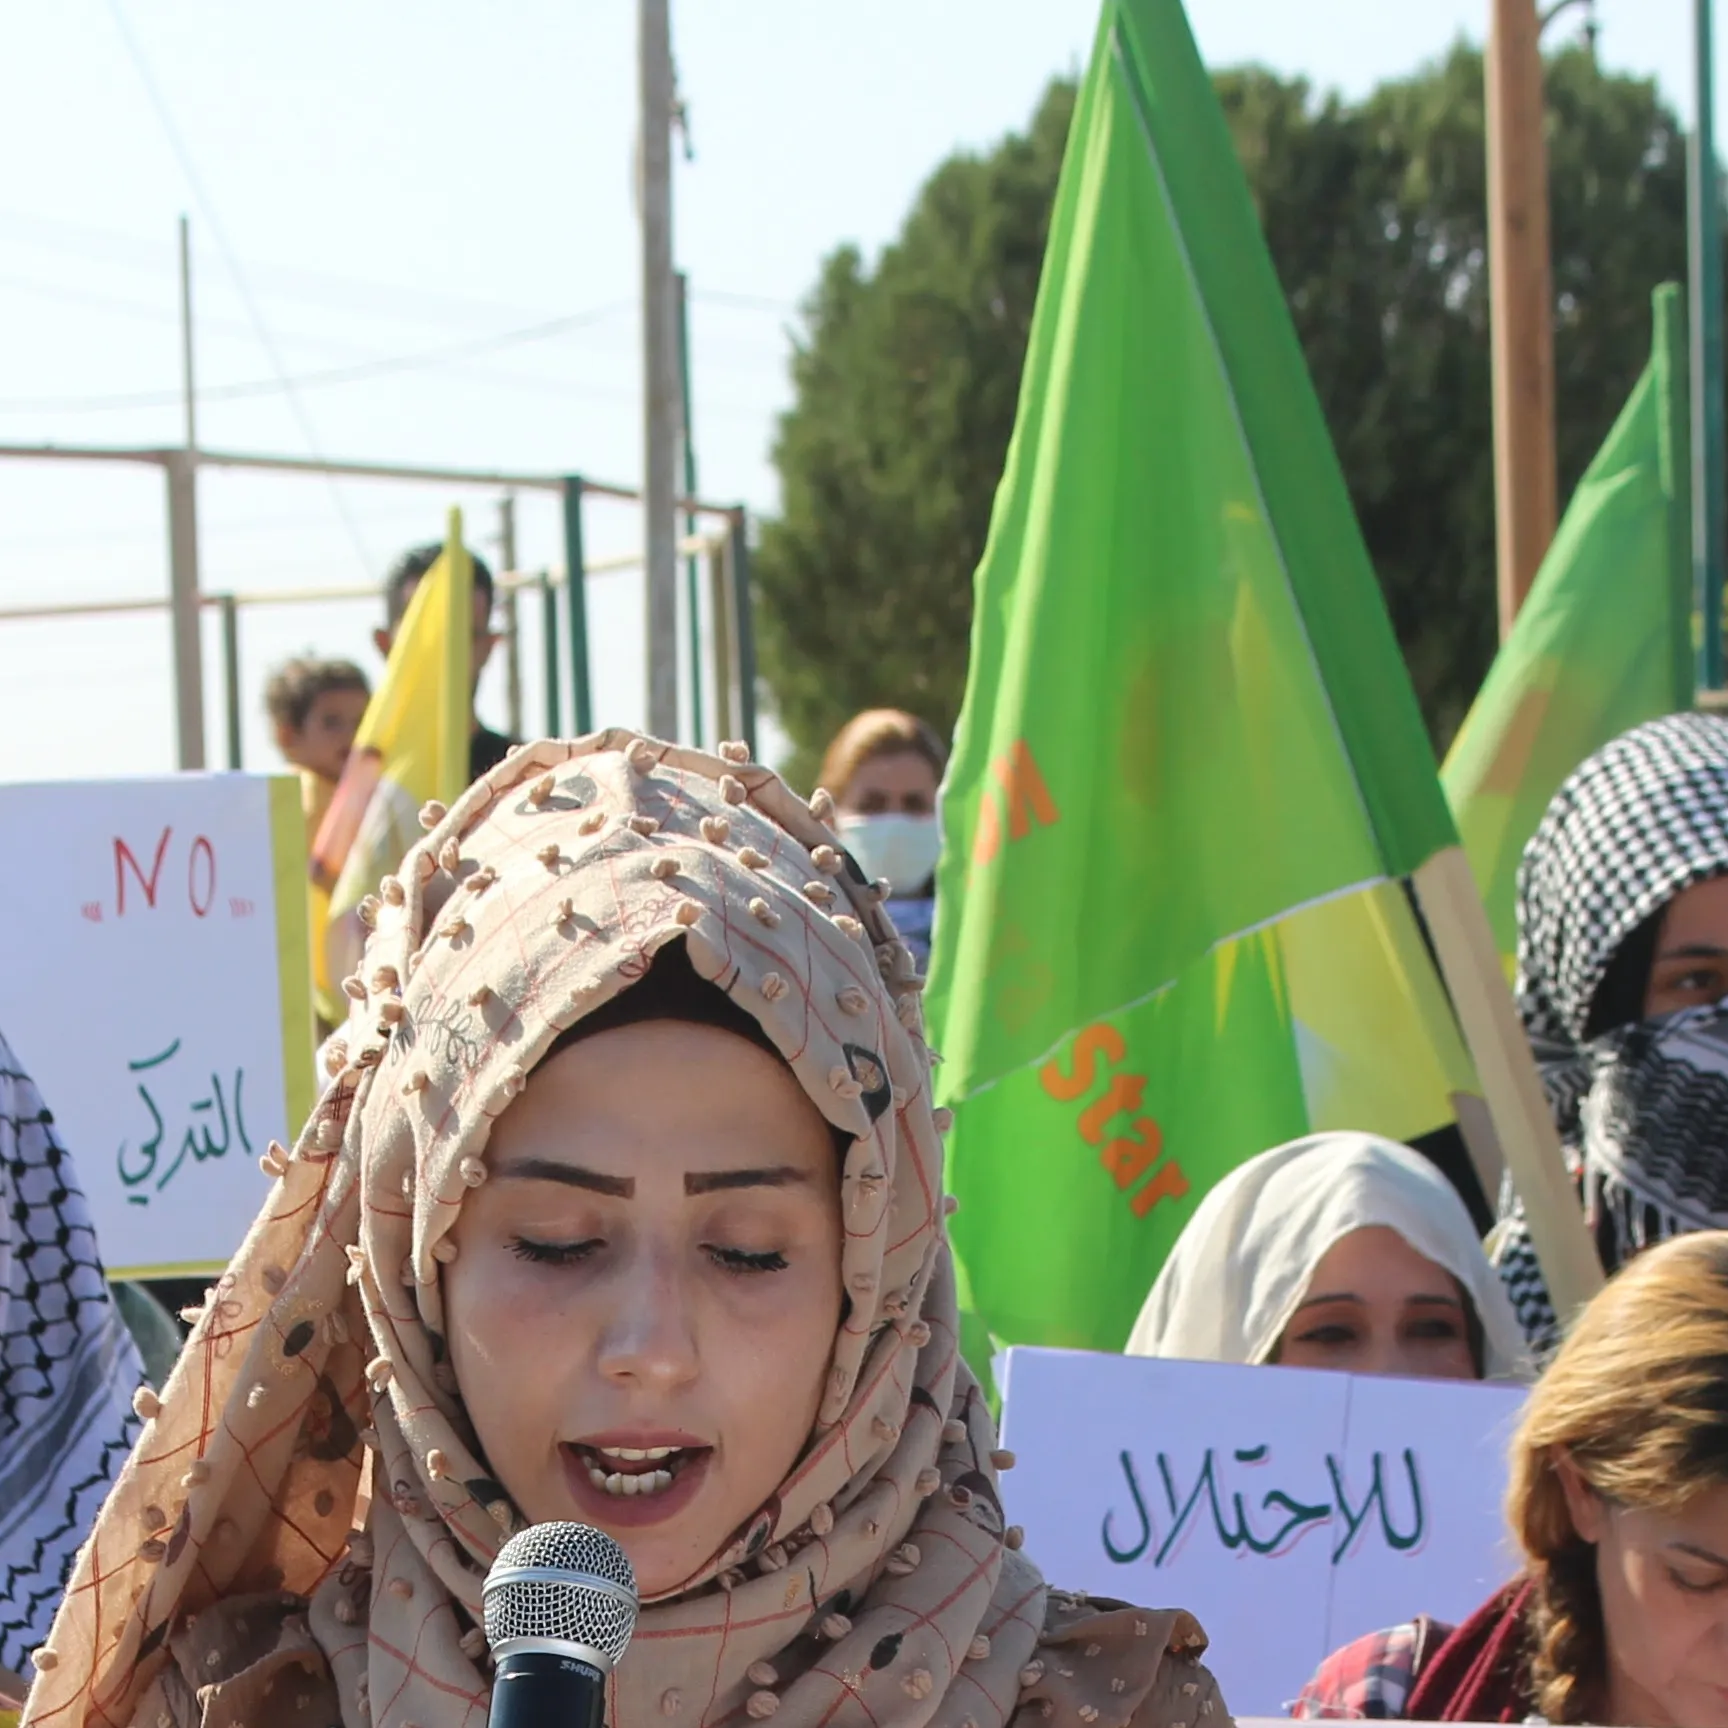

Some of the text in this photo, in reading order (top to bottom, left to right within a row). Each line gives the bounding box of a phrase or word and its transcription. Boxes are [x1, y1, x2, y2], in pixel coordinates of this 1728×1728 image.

[118, 1038, 254, 1206] التركي
[1040, 1023, 1191, 1220] Star
[1101, 1442, 1426, 1567] للاحتلال
